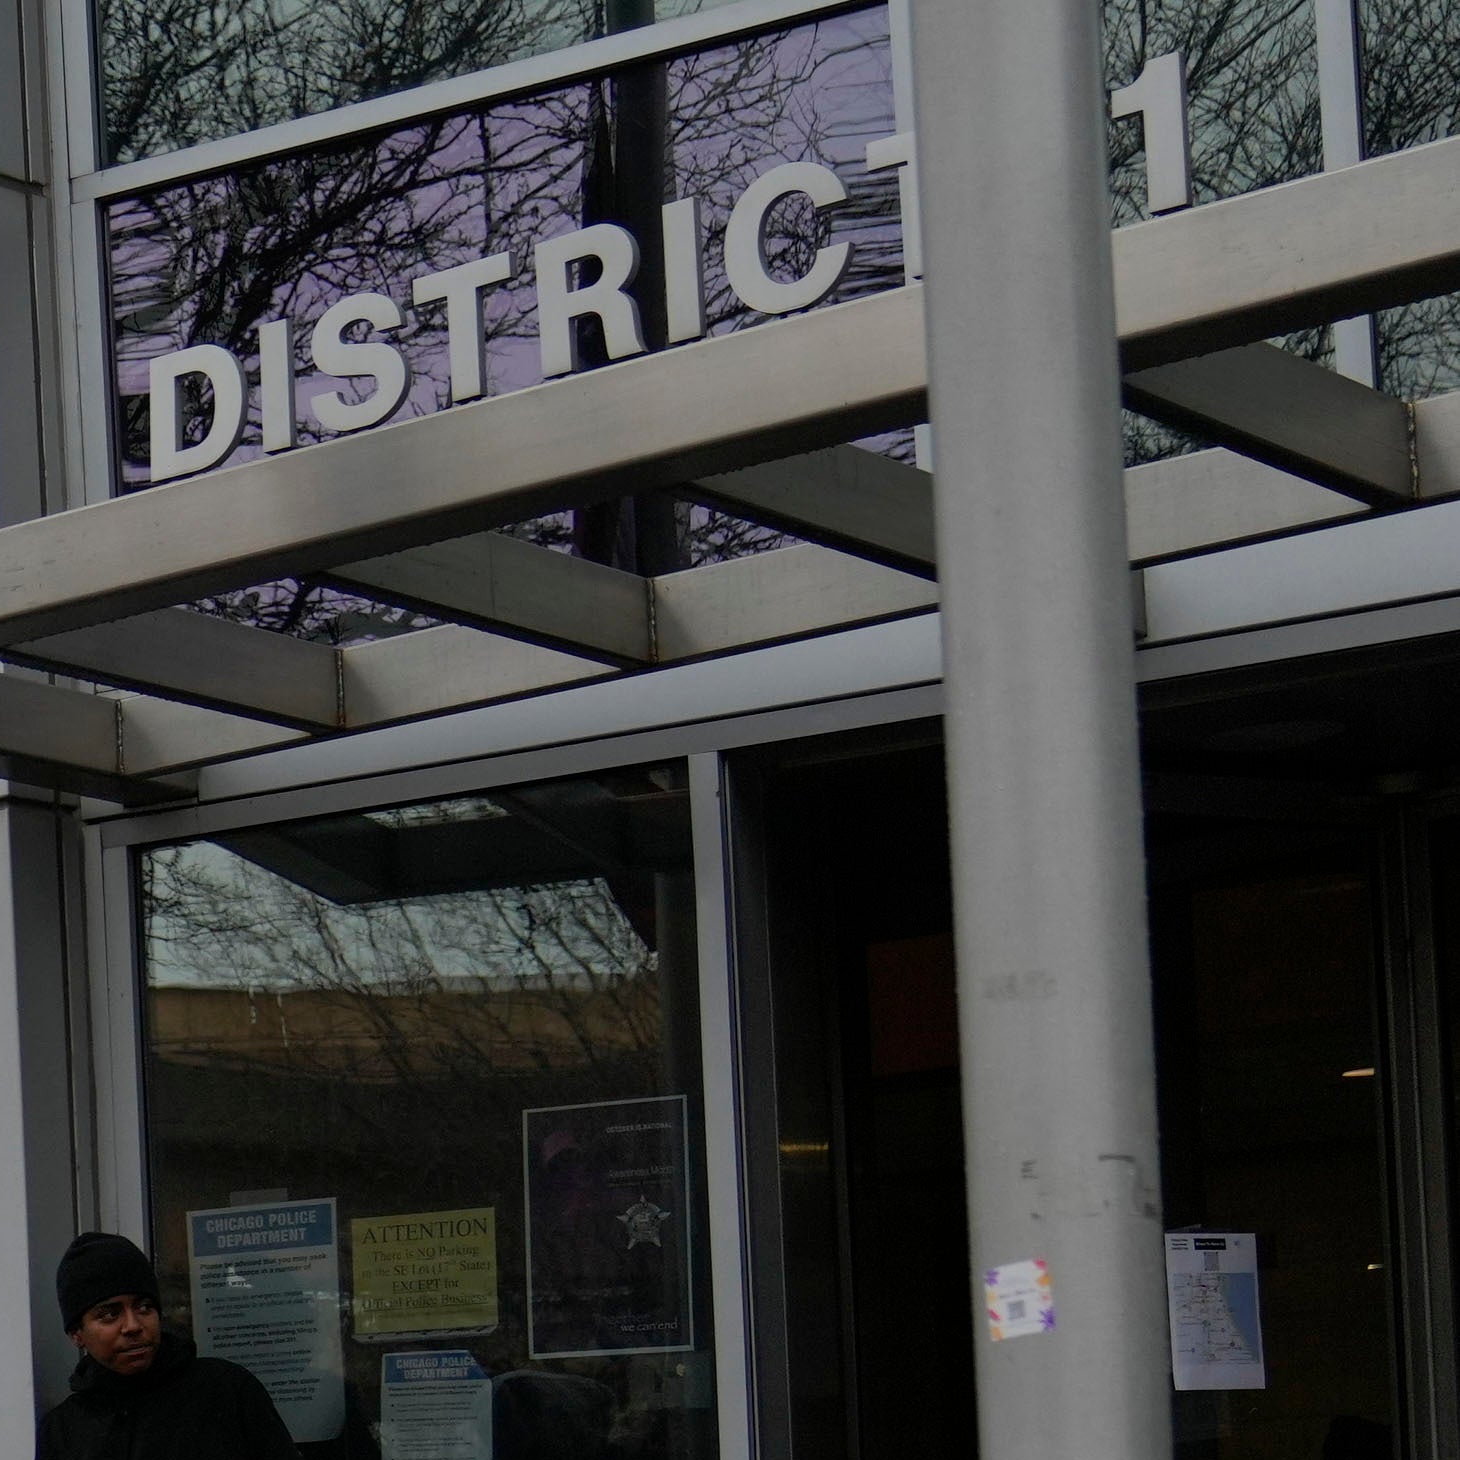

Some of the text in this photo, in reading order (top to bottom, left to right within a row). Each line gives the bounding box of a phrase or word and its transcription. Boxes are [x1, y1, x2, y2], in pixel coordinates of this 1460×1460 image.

[1111, 50, 1192, 214] 1
[206, 1210, 318, 1233] CHICAGO POLICE
[217, 1228, 307, 1249] DEPARTMENT
[361, 1218, 488, 1244] ATTENTION
[372, 1245, 481, 1263] There is NO Parking
[393, 1265, 409, 1276] SE
[393, 1277, 460, 1291] EXCEPT for
[405, 1295, 437, 1308] Police
[396, 1357, 439, 1369] CHICAGO
[404, 1366, 469, 1379] DEPARTMENT
